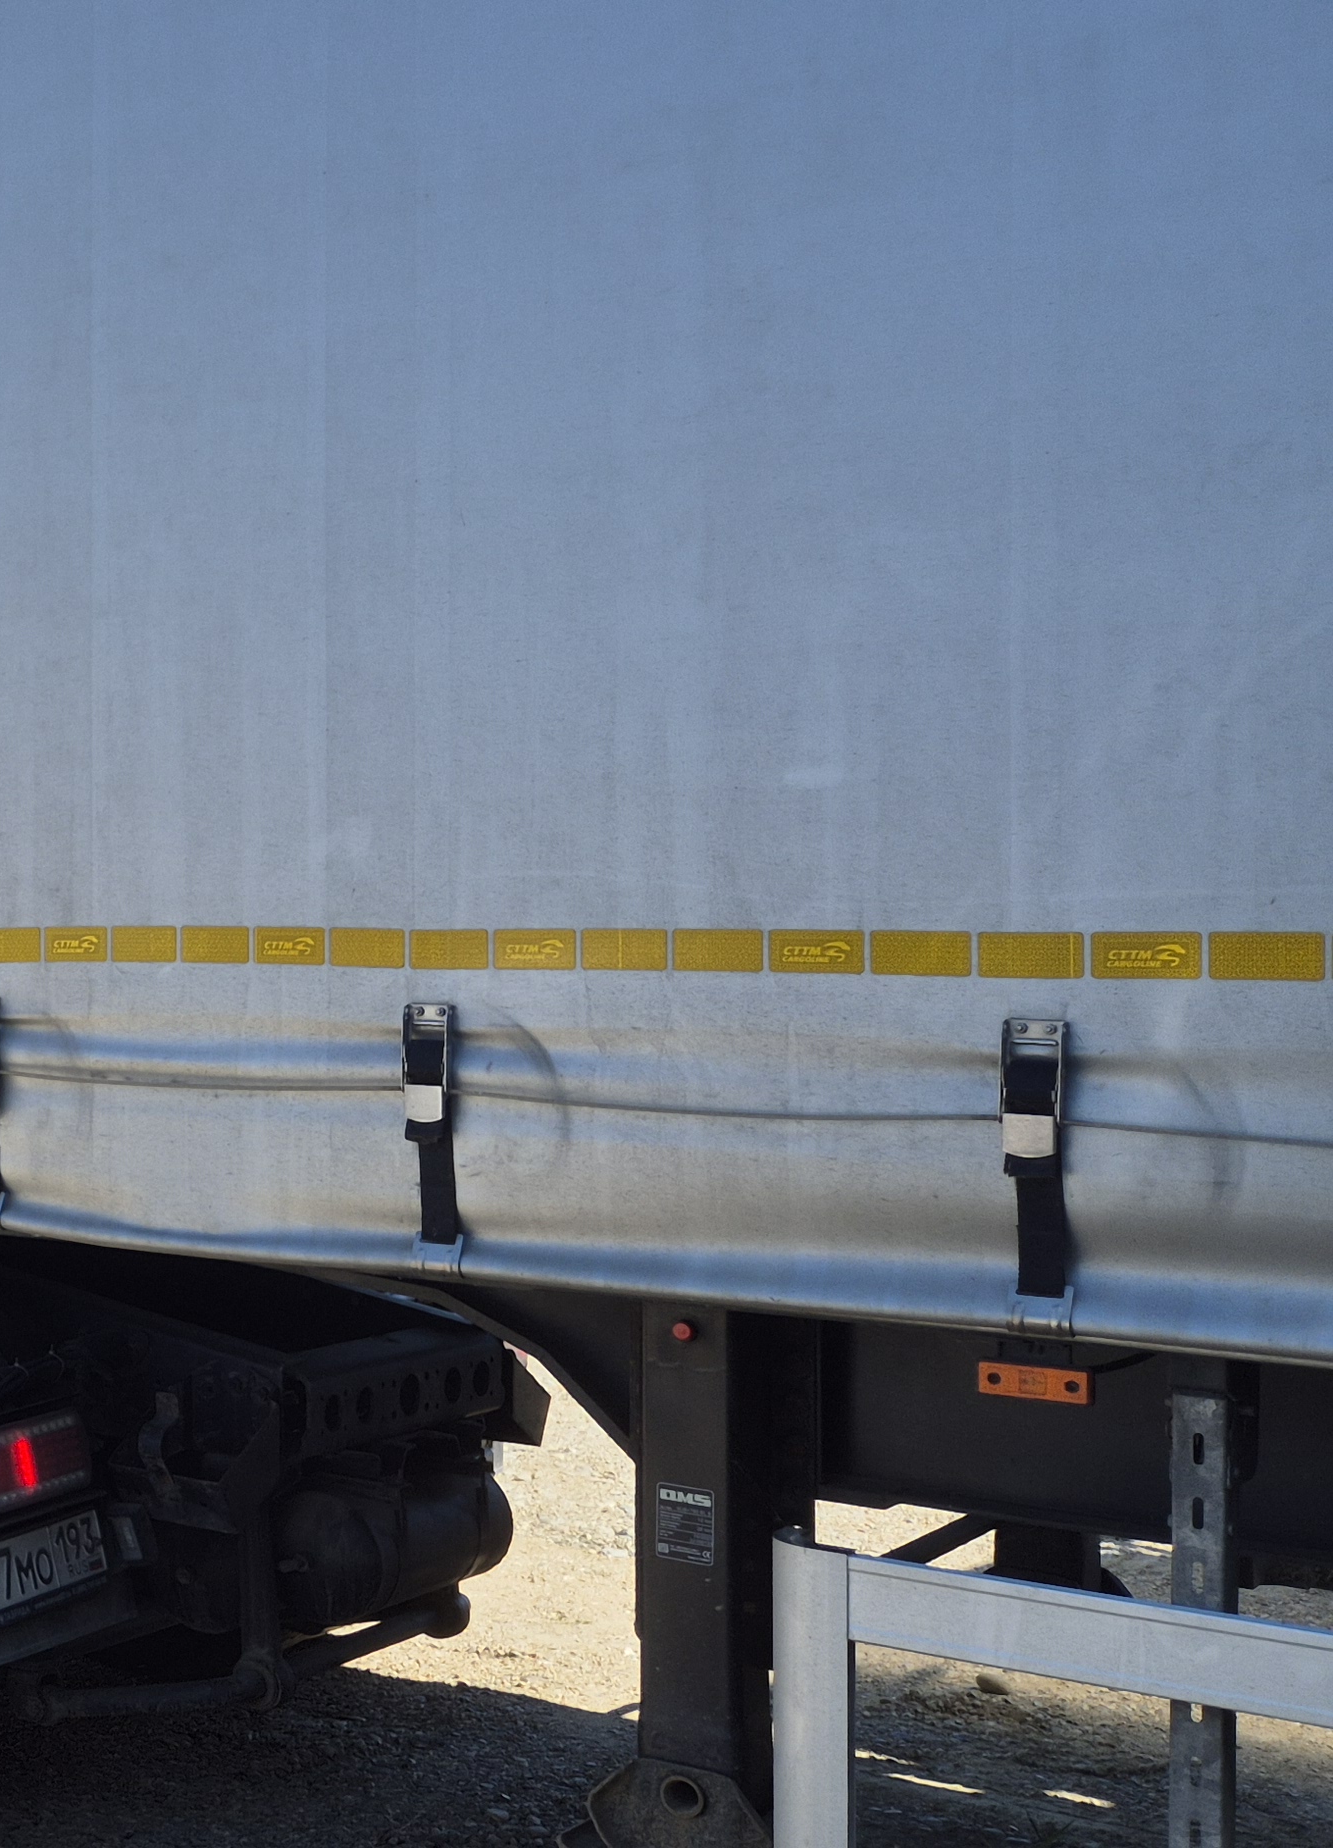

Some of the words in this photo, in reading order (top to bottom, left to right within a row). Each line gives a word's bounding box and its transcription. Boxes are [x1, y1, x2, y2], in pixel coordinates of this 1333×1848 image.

[783, 946, 821, 955] CTTM
[1107, 949, 1152, 960] CTTM
[54, 1517, 96, 1564] 193
[68, 1561, 89, 1577] RUS
